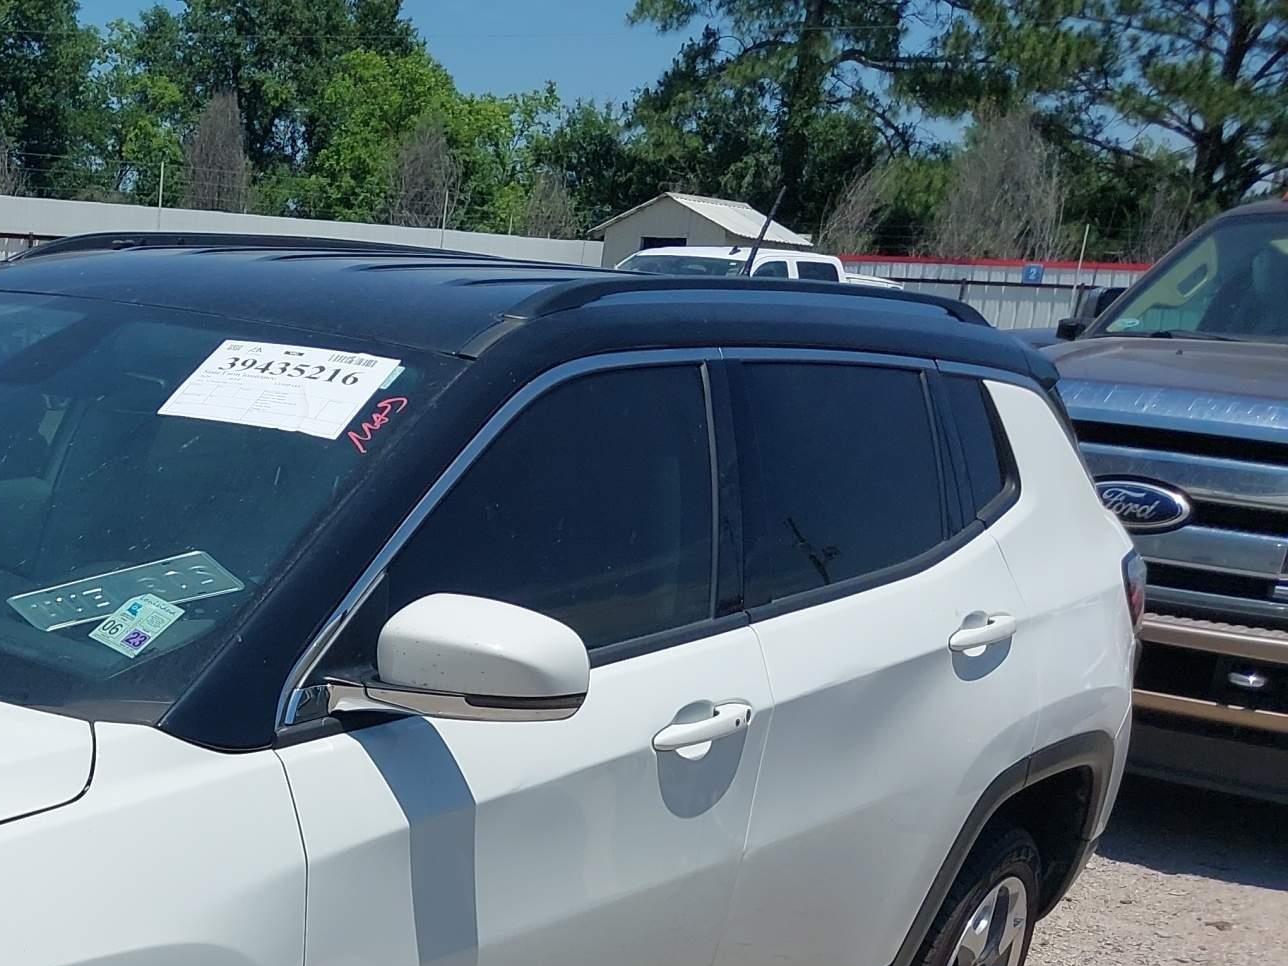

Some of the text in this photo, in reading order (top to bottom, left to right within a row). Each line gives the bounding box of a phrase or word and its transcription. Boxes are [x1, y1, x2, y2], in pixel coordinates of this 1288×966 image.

[1028, 268, 1037, 279] 2
[217, 357, 366, 385] 39435216
[1102, 487, 1160, 520] Ford
[102, 619, 123, 635] 06
[124, 631, 148, 648] 23
